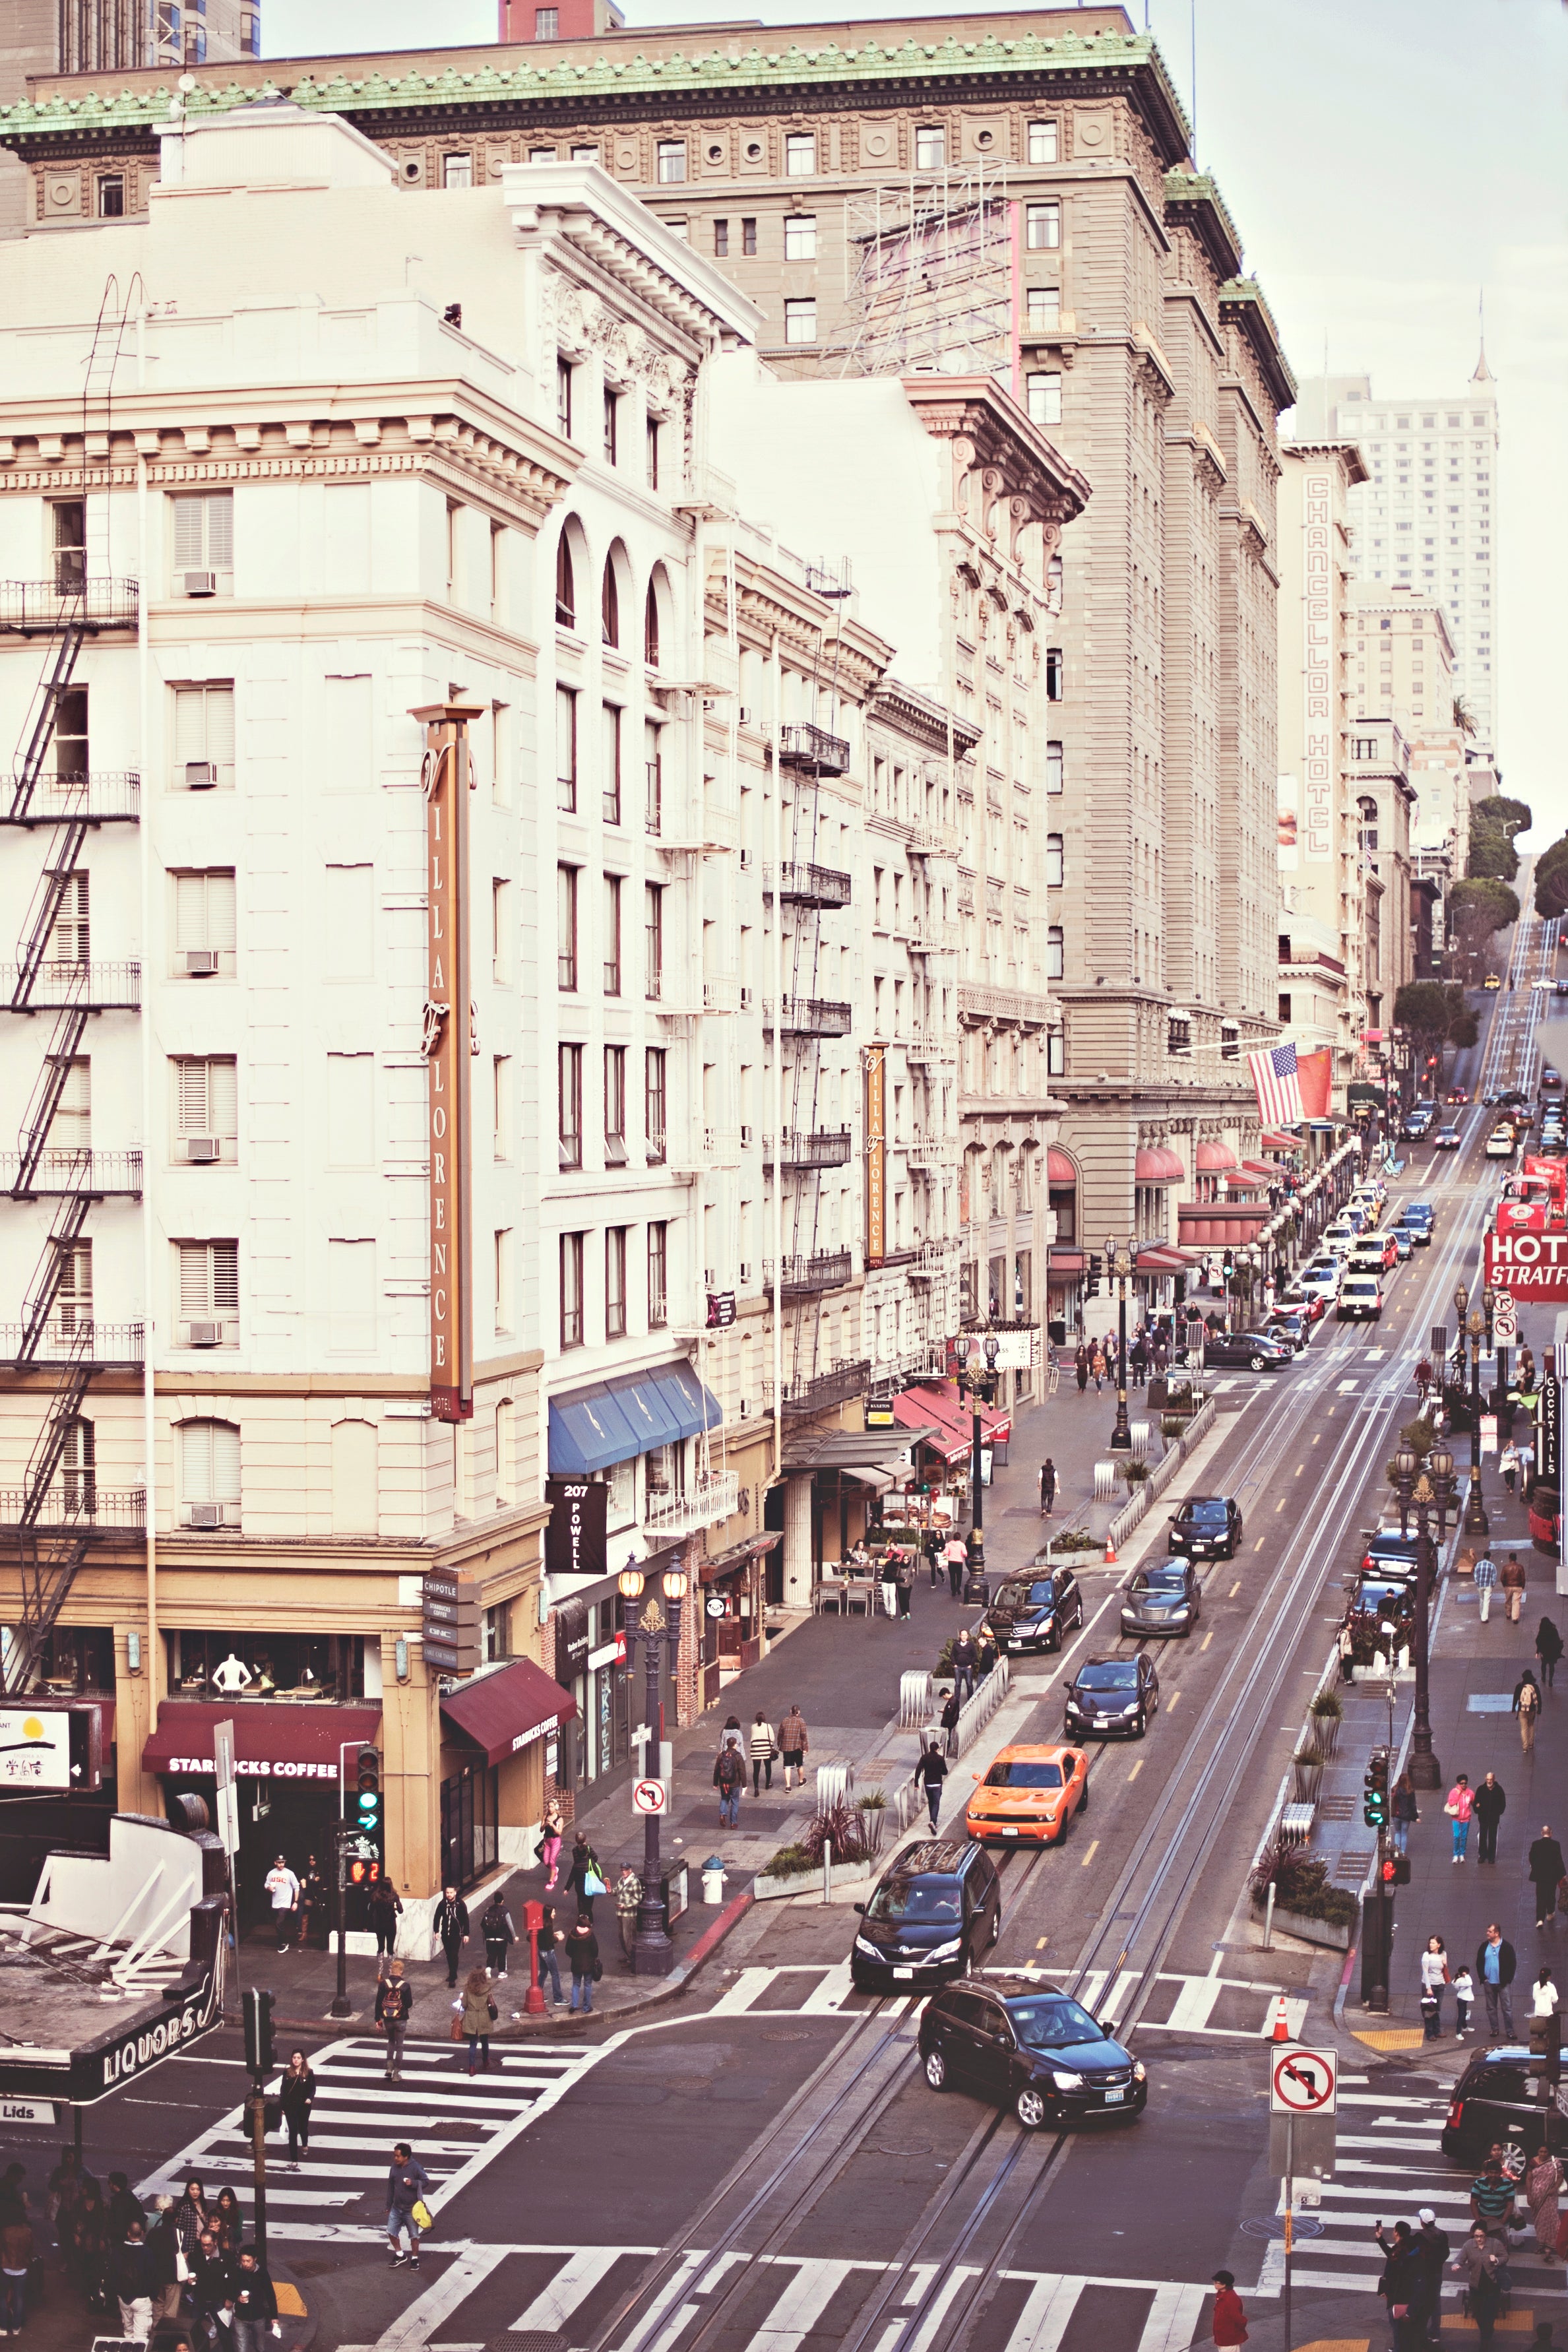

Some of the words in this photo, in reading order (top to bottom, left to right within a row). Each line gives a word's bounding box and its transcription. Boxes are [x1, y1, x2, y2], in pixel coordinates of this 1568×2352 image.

[1307, 478, 1328, 717] CHANCELLOR
[1308, 735, 1330, 852] HOTEL
[420, 742, 455, 989] VILLA
[865, 1055, 885, 1131] VILLA
[420, 1000, 451, 1367] FLORENCE
[865, 1135, 885, 1250] FLORENCE
[1491, 1235, 1568, 1263] HOT
[1491, 1265, 1568, 1285] STRATF
[433, 1397, 451, 1411] HOTEL
[564, 1485, 588, 1498] 207
[570, 1503, 582, 1569] POWELL
[424, 1581, 456, 1597] CHIPOTLE
[429, 1603, 451, 1613] STARBUCKS
[433, 1609, 447, 1618] COFFEE
[429, 1628, 452, 1639] GNC
[513, 1724, 541, 1752] STARBUCKS
[540, 1714, 558, 1734] COFFEE
[273, 1762, 338, 1778] COFFEE
[370, 1862, 379, 1880] 2
[104, 2007, 195, 2085] LIQUORS
[3, 2105, 35, 2119] Lids
